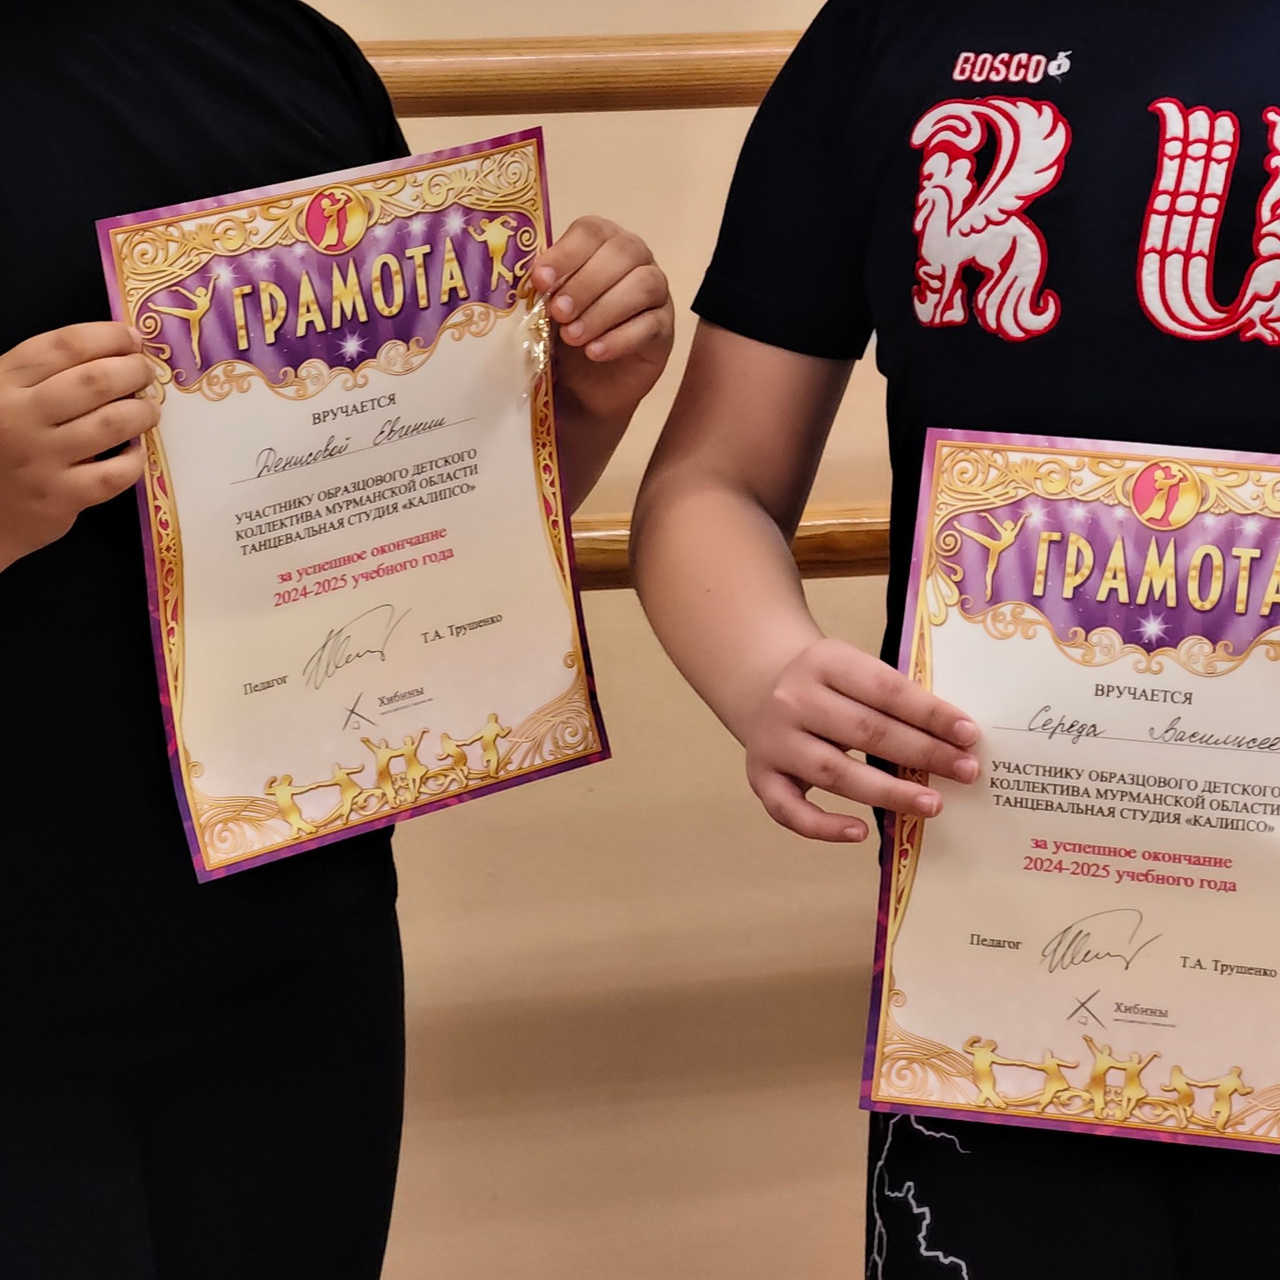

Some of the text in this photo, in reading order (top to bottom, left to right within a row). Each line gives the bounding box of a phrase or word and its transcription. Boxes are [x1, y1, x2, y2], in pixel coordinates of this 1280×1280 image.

[232, 235, 469, 351] ГРАМОТА
[312, 393, 396, 425] ВРУЧАЕТСЯ
[235, 448, 477, 525] УЧАСТНИКУ ОБРАЗЦОВОГО ДЕТСКОГО
[236, 464, 479, 541] КОЛЛЕКТИВА МУРМАНСКОЙ ОБЛАСТИ
[240, 484, 476, 556] ТАНЦЕВАЛЬНАЯ СТУДИЯ «КАЛИПСО»
[277, 527, 447, 584] за успешное окончание
[274, 548, 455, 607] 2024-2025 учебного года
[421, 613, 503, 644] Т.А. Трушенко
[243, 674, 289, 696] Педагог
[378, 686, 425, 707] Хибины
[1094, 683, 1193, 705] ВРУЧАЕТСЯ
[991, 760, 1085, 780] УЧАСТНИКУ
[1088, 770, 1198, 792] ОБРАЗЦОВОГО
[989, 777, 1280, 816] КОЛЛЕКТИВА МУРМАНСКОЙ ОБЛАСТИ
[993, 794, 1275, 833] ТАНЦЕВАЛЬНАЯ СТУДИЯ «КАЛИПСО»
[1030, 837, 1233, 869] за успешное окончание
[1023, 856, 1237, 893] 2024-2025 учебного года
[969, 933, 1023, 951] Педагог
[1180, 956, 1277, 978] Т.А. Трушенко
[1114, 1001, 1168, 1018] Хибины
